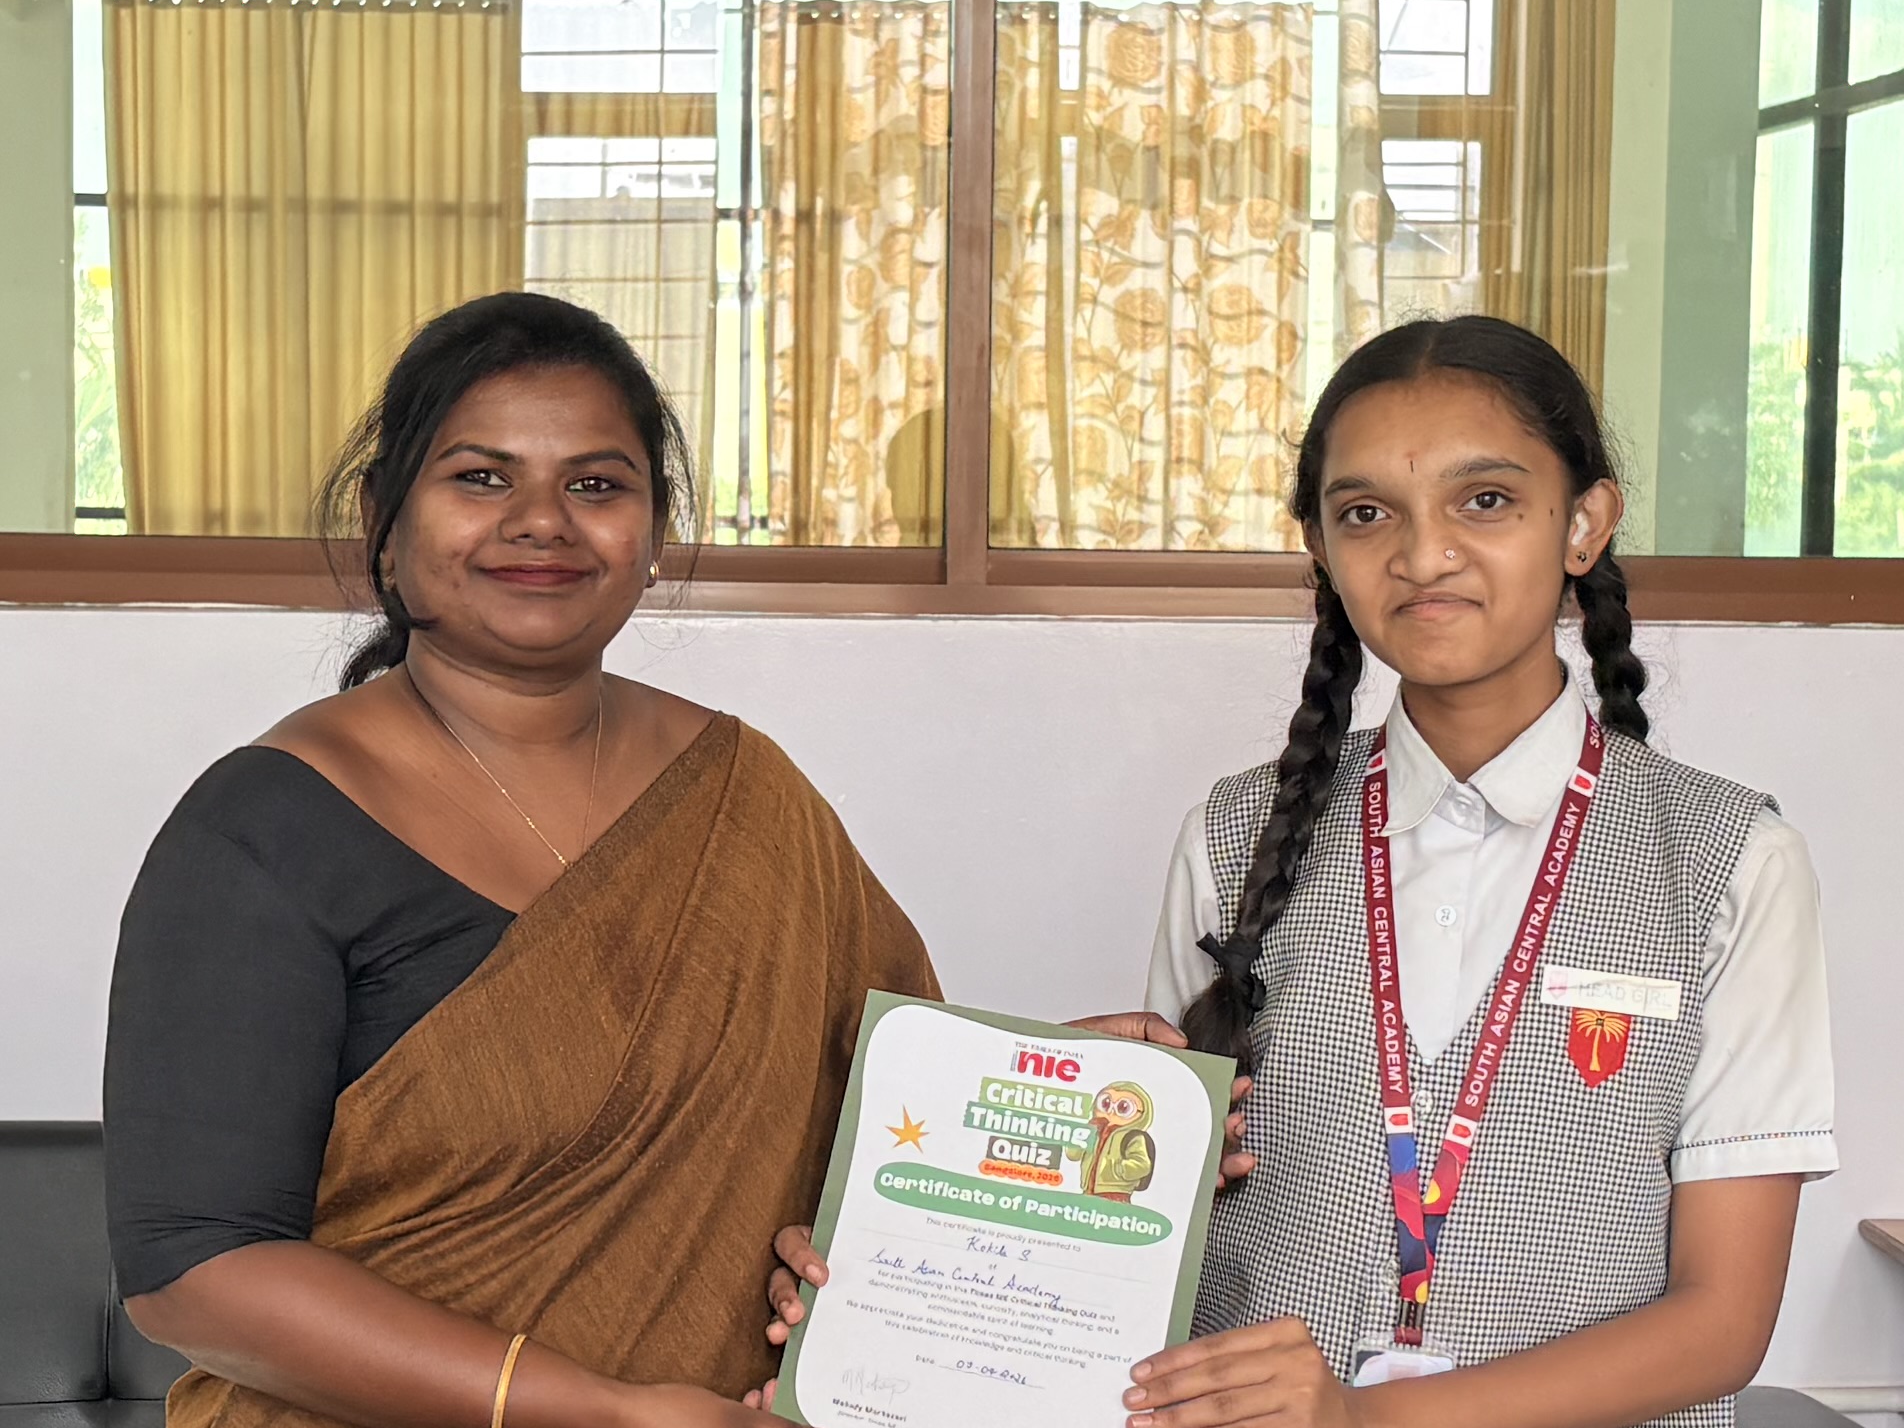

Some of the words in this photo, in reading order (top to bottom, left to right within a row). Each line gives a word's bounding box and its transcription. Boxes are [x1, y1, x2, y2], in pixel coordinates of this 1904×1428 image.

[1369, 782, 1381, 837] SOUTH
[1370, 845, 1386, 899] ASIAN
[1374, 906, 1392, 992] CENTRAL
[1465, 1042, 1498, 1107] SOUTH
[1490, 979, 1521, 1037] ASIAN
[1512, 893, 1552, 973] CENTRAL
[1544, 802, 1581, 887] ACADEMY
[1578, 981, 1626, 1001] HEAD
[1017, 1051, 1081, 1082] nie
[1381, 999, 1403, 1094] ACADEMY
[986, 1082, 1084, 1116] Critical
[971, 1106, 1091, 1149] Thinking
[992, 1139, 1052, 1165] Quiz
[880, 1172, 995, 1206] Certificate
[999, 1193, 1022, 1211] of
[1026, 1199, 1162, 1237] Participation
[996, 1231, 1026, 1244] proudly
[1028, 1237, 1071, 1251] presented
